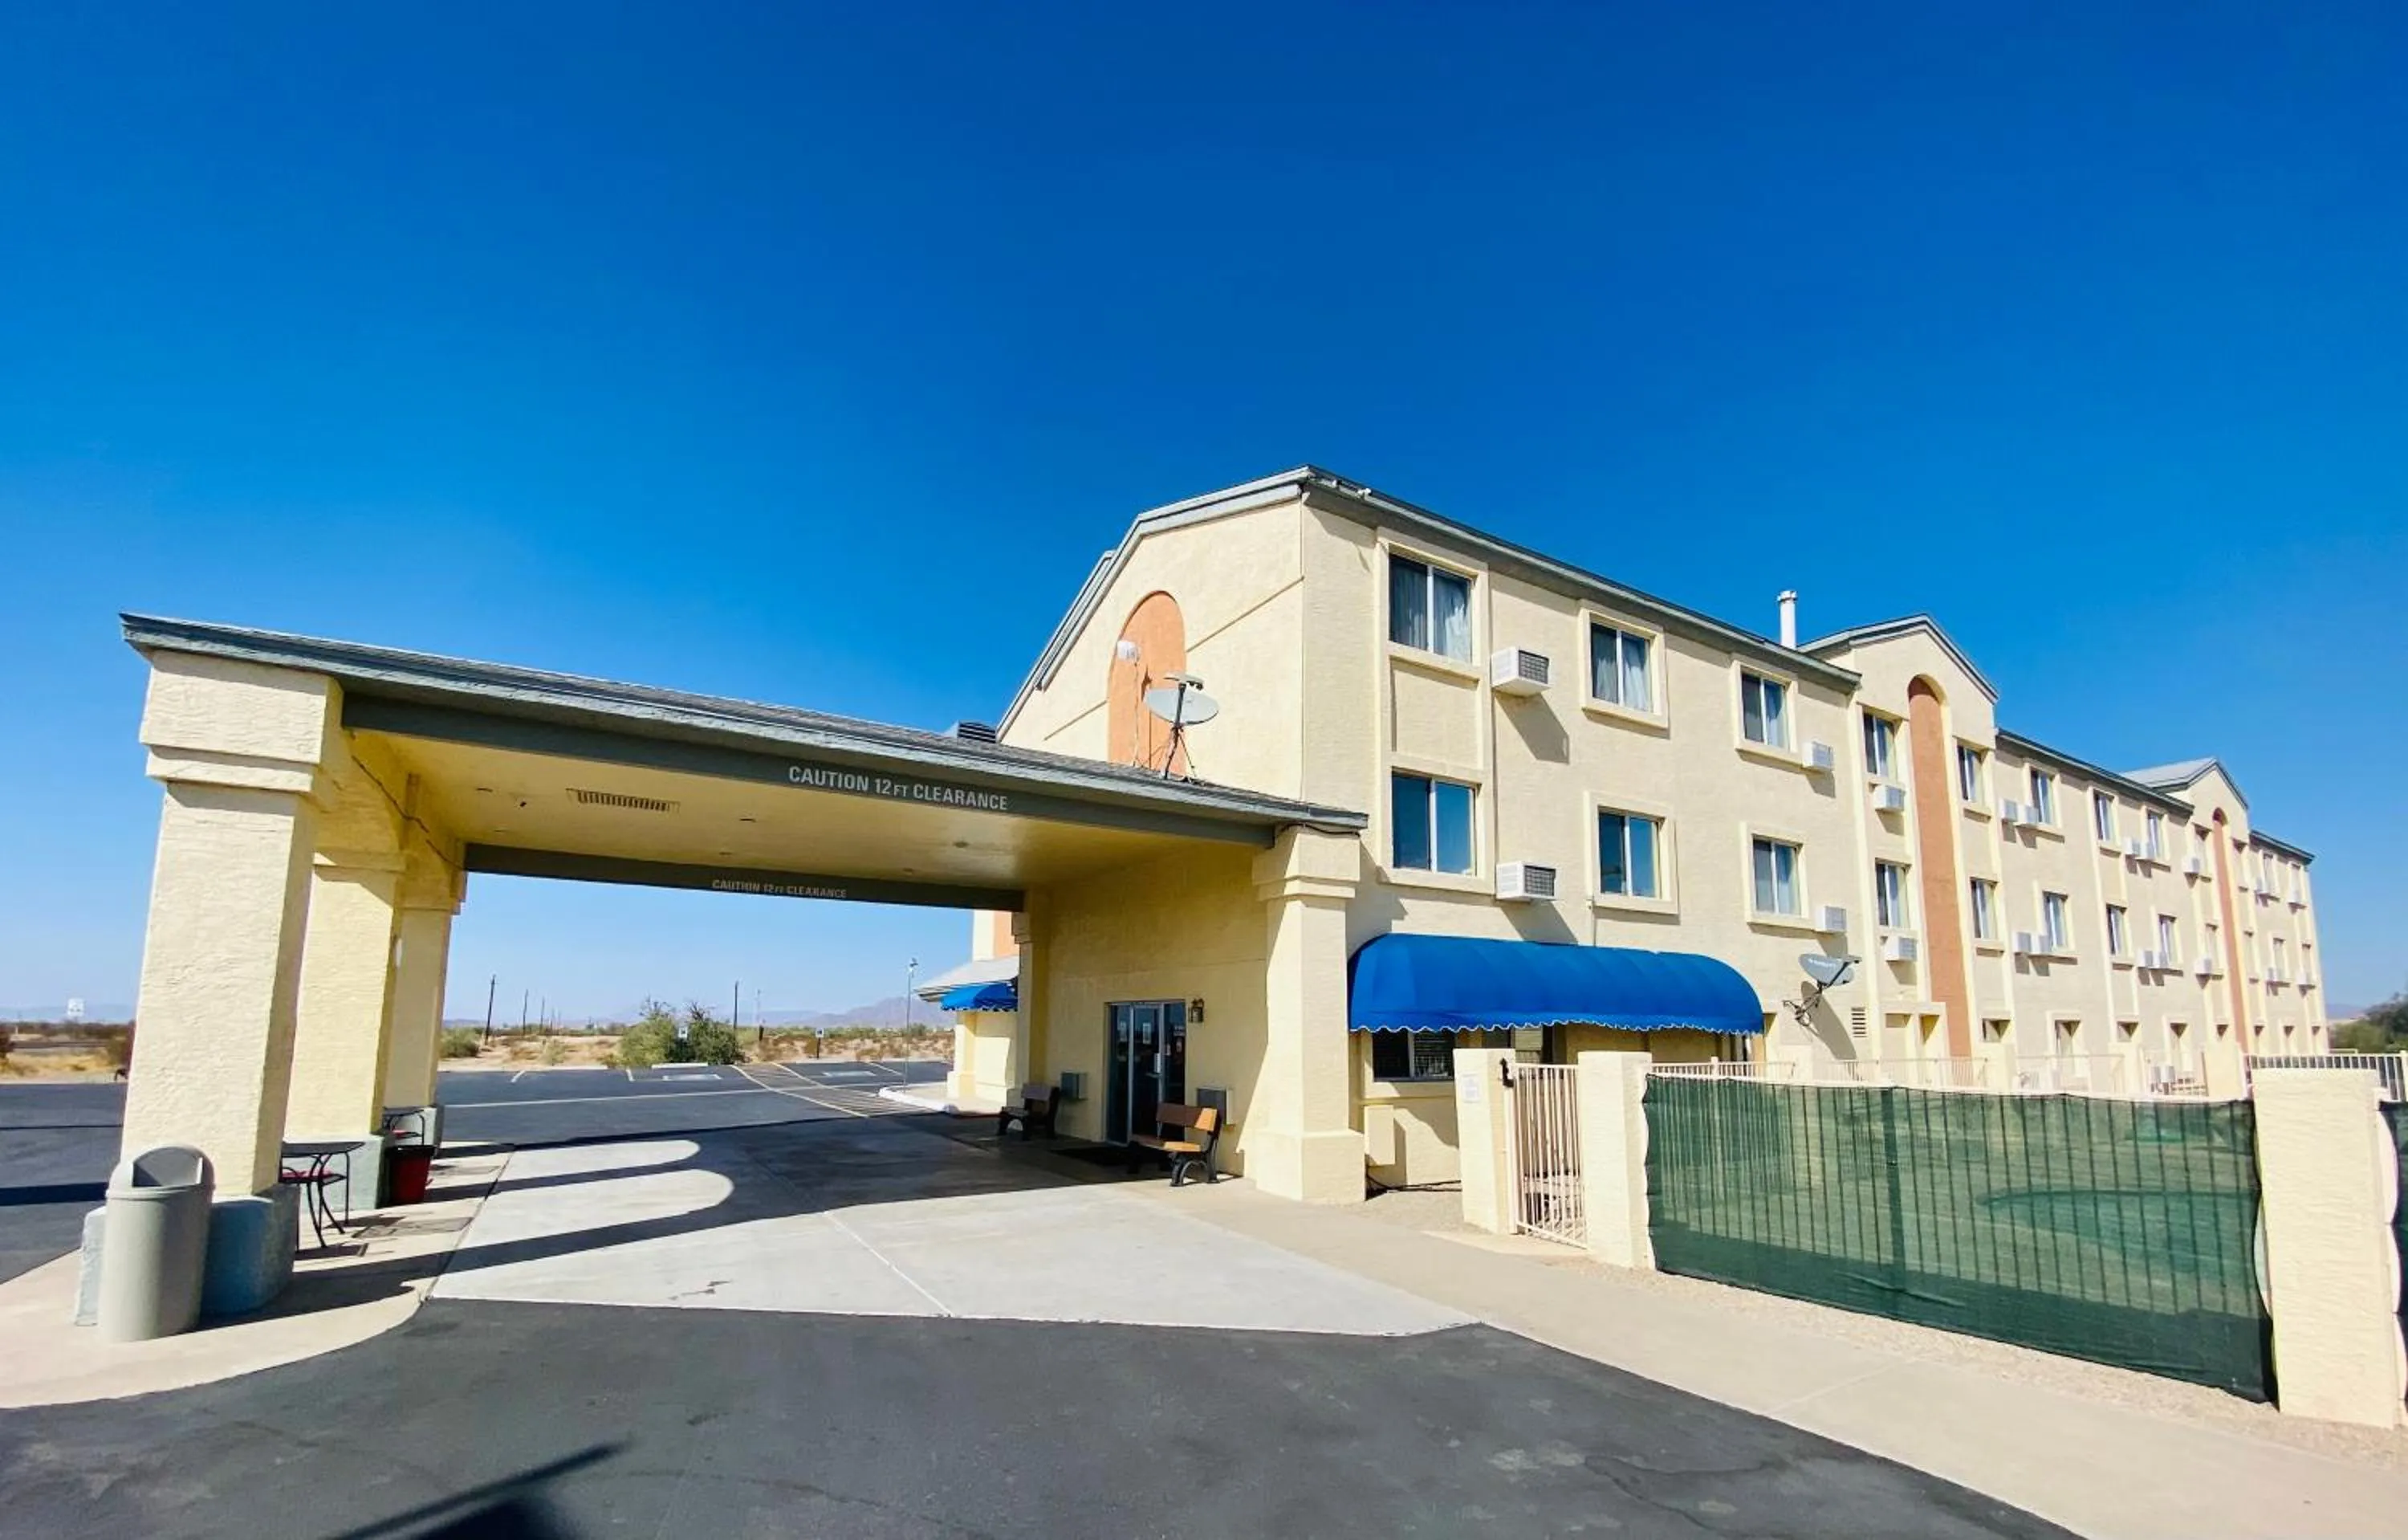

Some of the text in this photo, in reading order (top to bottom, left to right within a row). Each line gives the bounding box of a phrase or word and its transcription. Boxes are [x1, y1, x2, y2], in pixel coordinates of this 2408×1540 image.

[789, 765, 869, 792] CAUTION
[913, 784, 1008, 810] CLEARANCE
[712, 879, 760, 892] CAUTION
[787, 886, 847, 898] CLEARANCE
